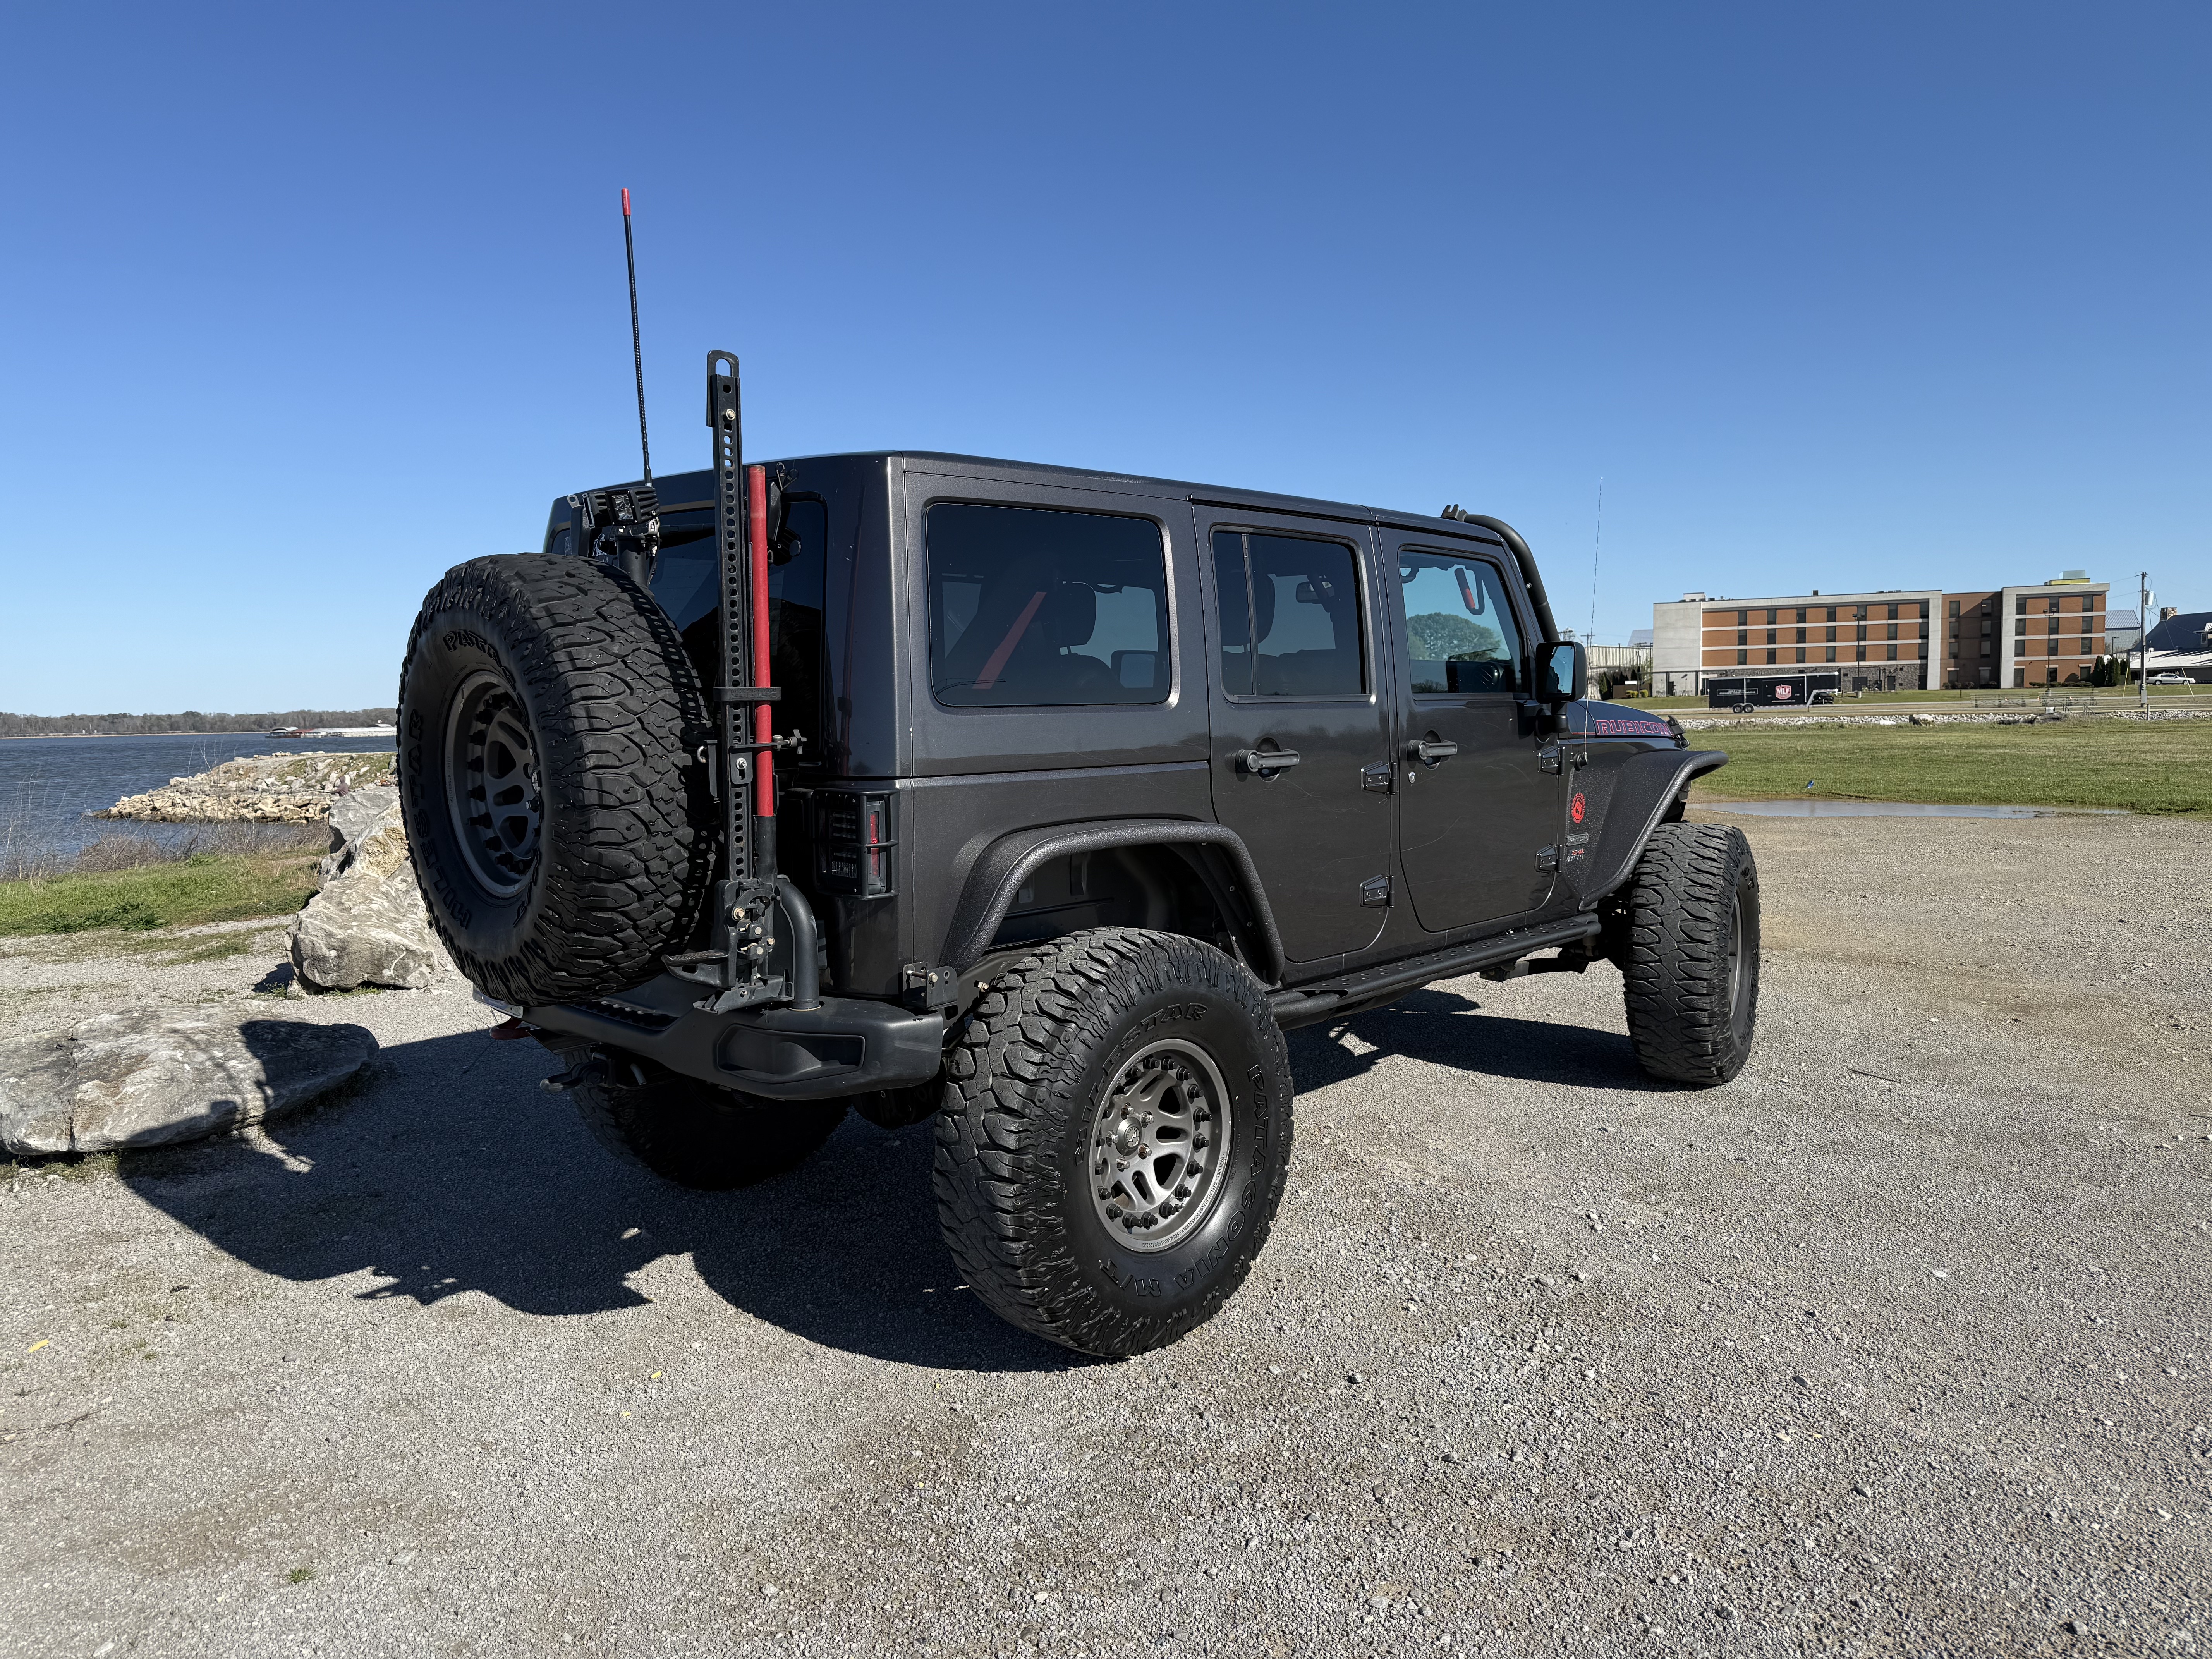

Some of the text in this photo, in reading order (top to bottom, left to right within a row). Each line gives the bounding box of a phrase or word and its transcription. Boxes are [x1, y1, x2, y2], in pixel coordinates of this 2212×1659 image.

[407, 708, 471, 929] MILESTAR
[1596, 720, 1675, 736] RUBICON
[1075, 1002, 1208, 1166] MILESTAR
[1099, 1064, 1270, 1297] PATAGONIA M/T
